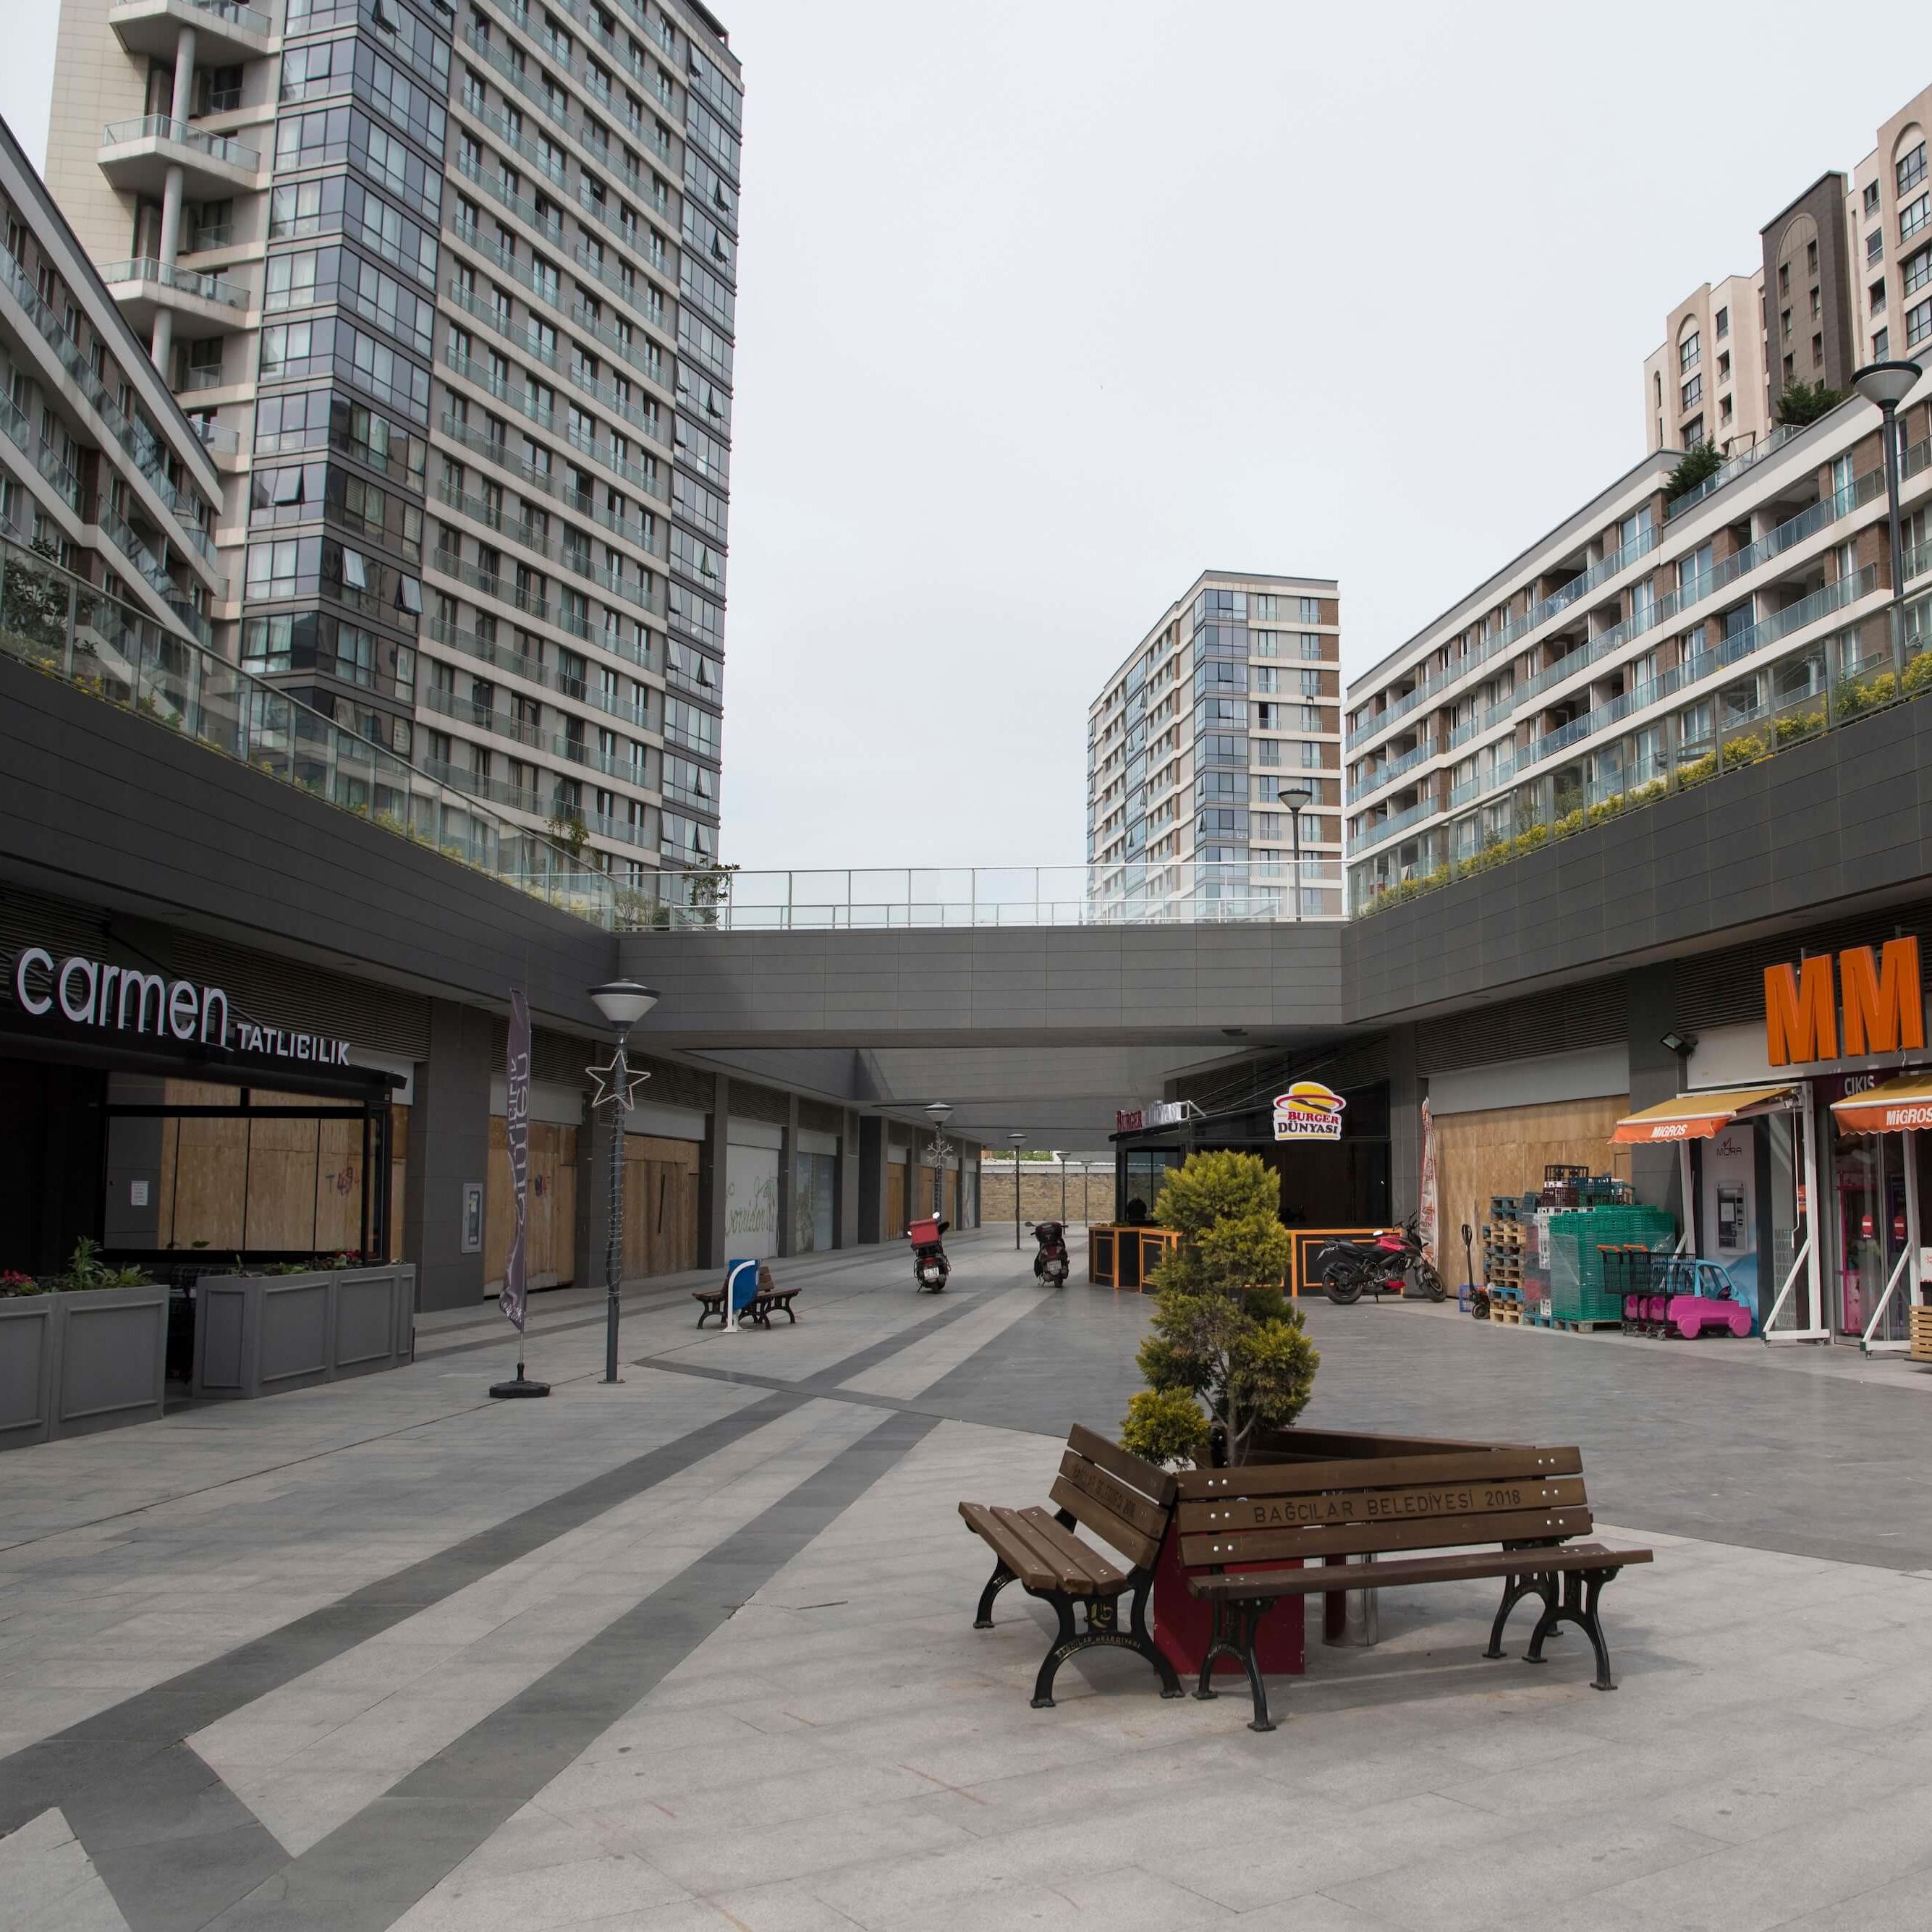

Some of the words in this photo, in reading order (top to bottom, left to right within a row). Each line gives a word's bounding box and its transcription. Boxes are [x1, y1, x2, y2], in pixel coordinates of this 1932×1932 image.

[16, 947, 229, 1046] carmen
[1764, 936, 1924, 1067] MM
[237, 1023, 350, 1066] TATLICILIK
[1278, 1121, 1339, 1134] DÜNYASI
[1288, 1111, 1339, 1124] BURGER
[1254, 1501, 1353, 1523] BAĞCILAR
[1367, 1489, 1474, 1515] BELEDİYESİ
[1486, 1489, 1521, 1507] 2018
